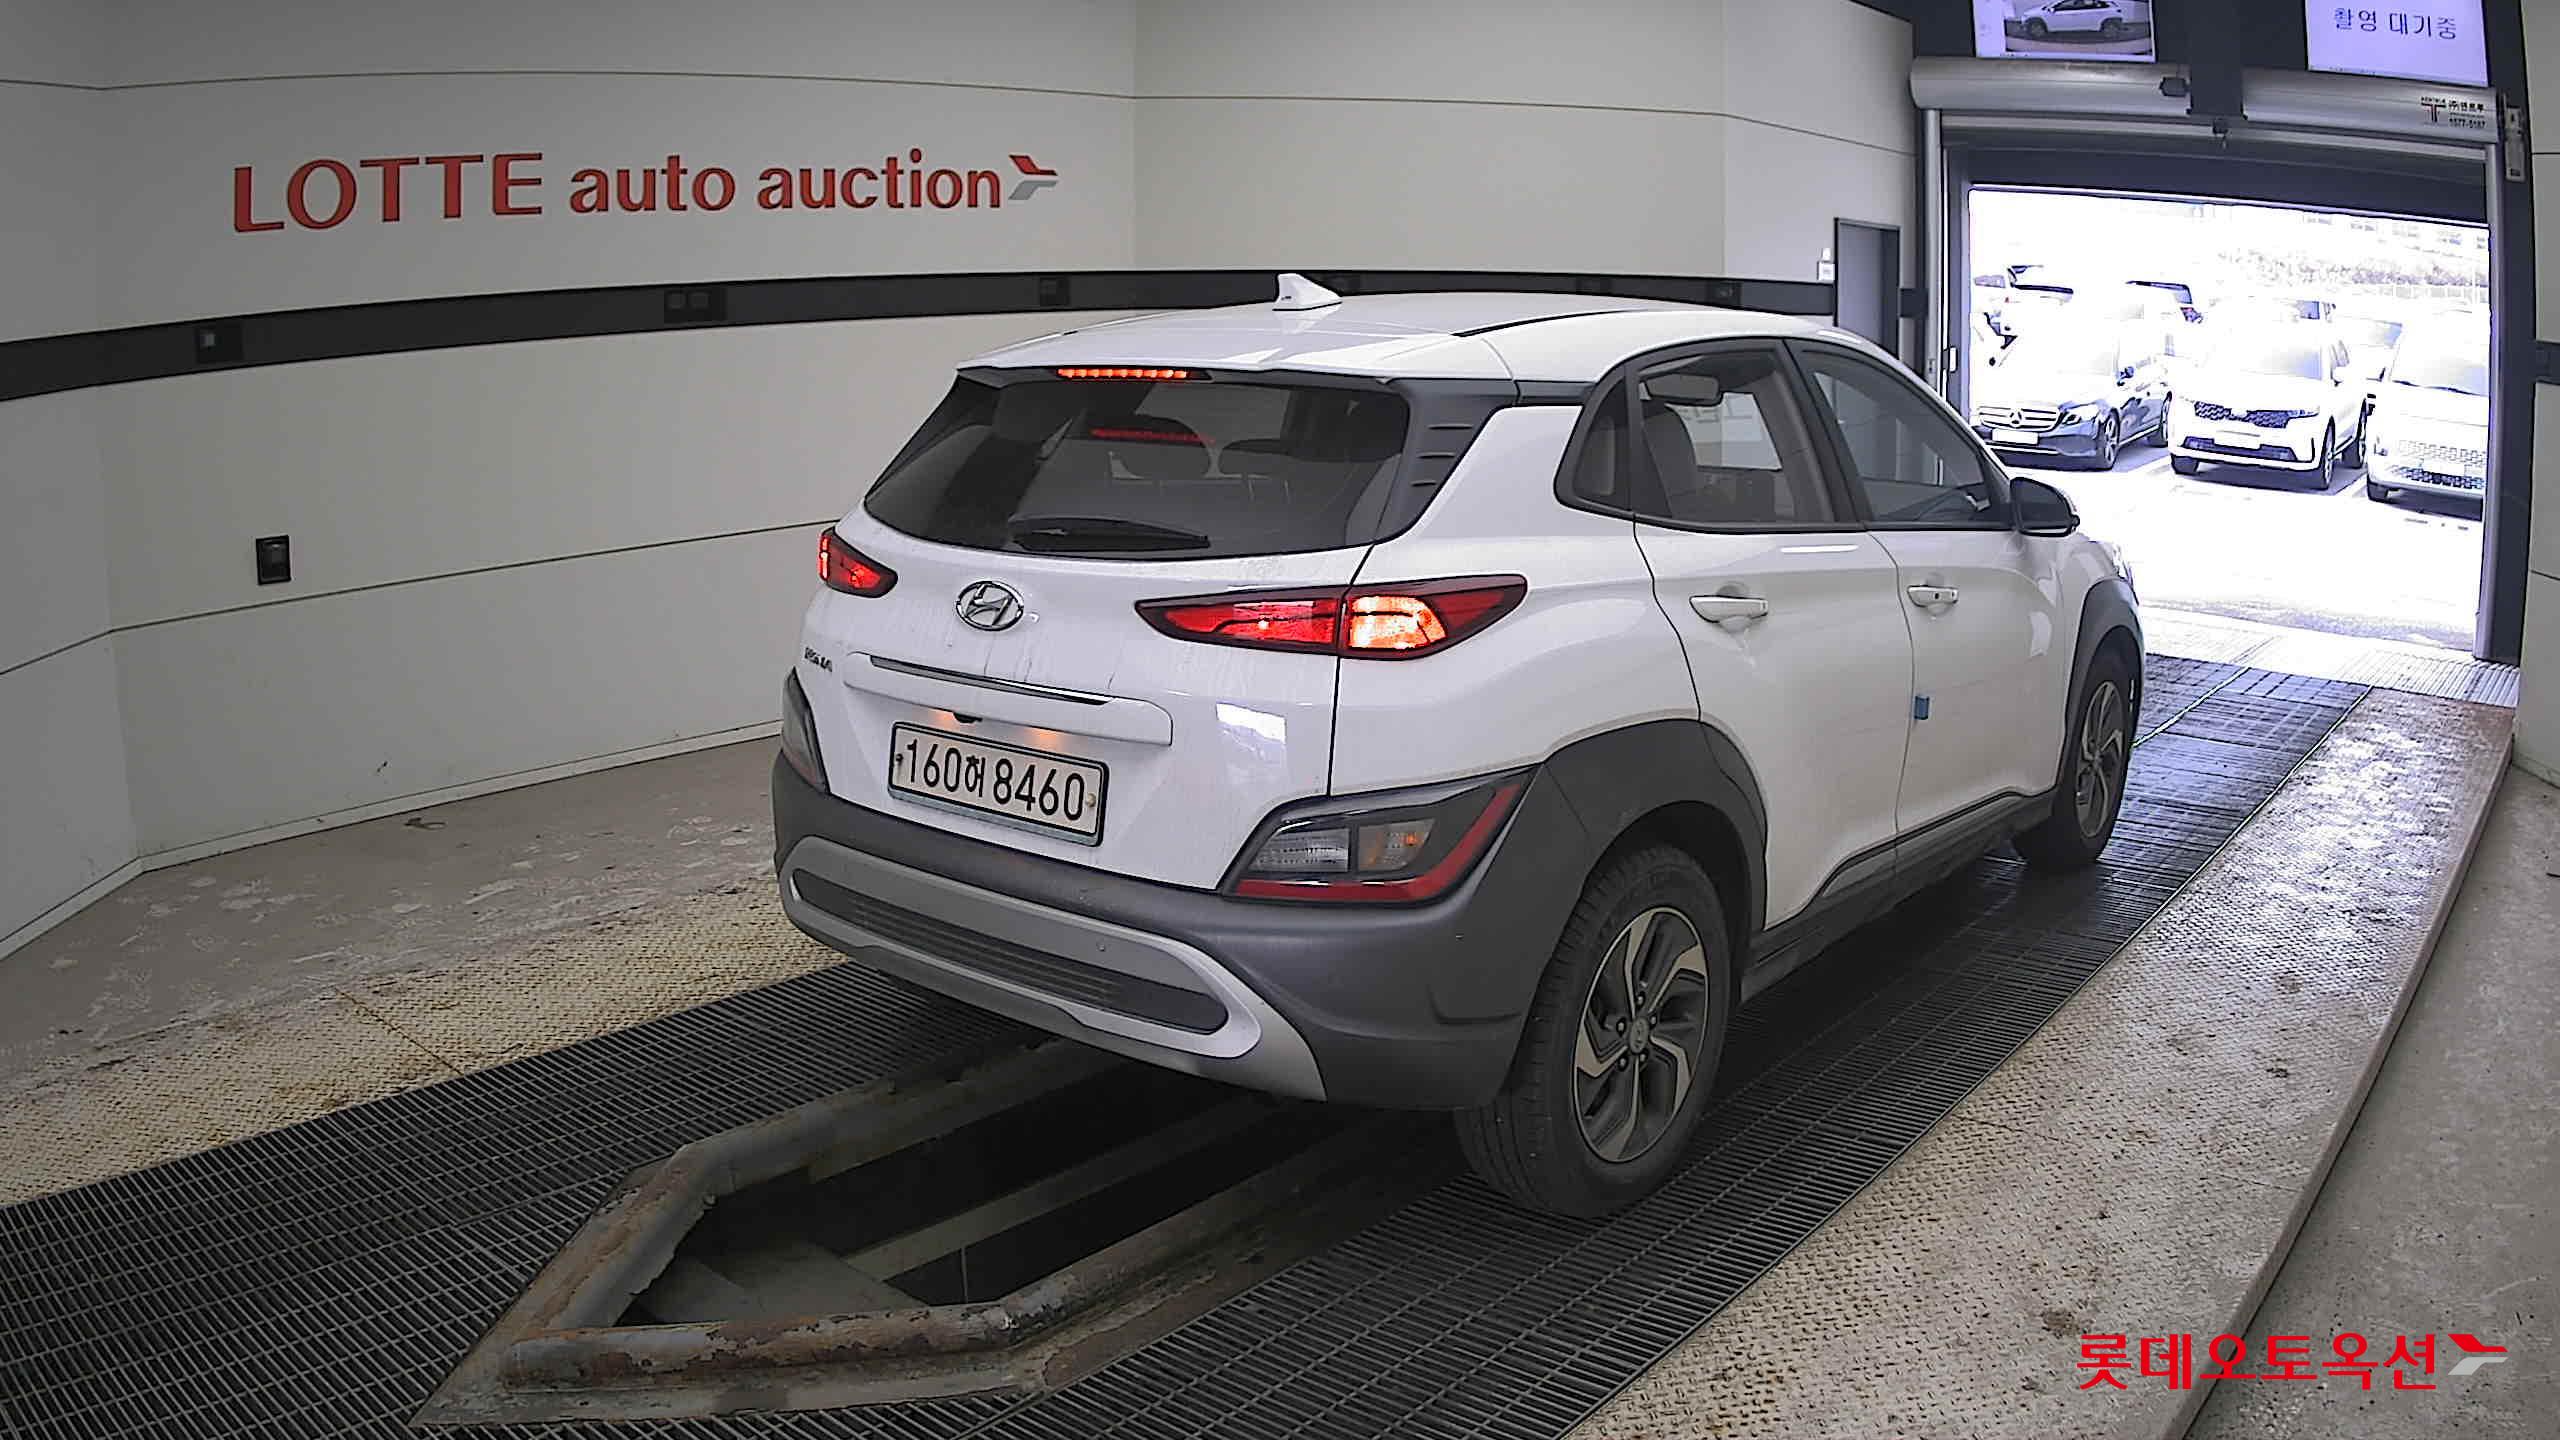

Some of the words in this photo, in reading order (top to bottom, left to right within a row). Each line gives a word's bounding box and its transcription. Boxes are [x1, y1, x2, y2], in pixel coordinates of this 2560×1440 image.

[2389, 12, 2457, 40] 대기중
[233, 153, 540, 233] LOTTE
[570, 155, 736, 213] auto
[757, 149, 1001, 209] auction
